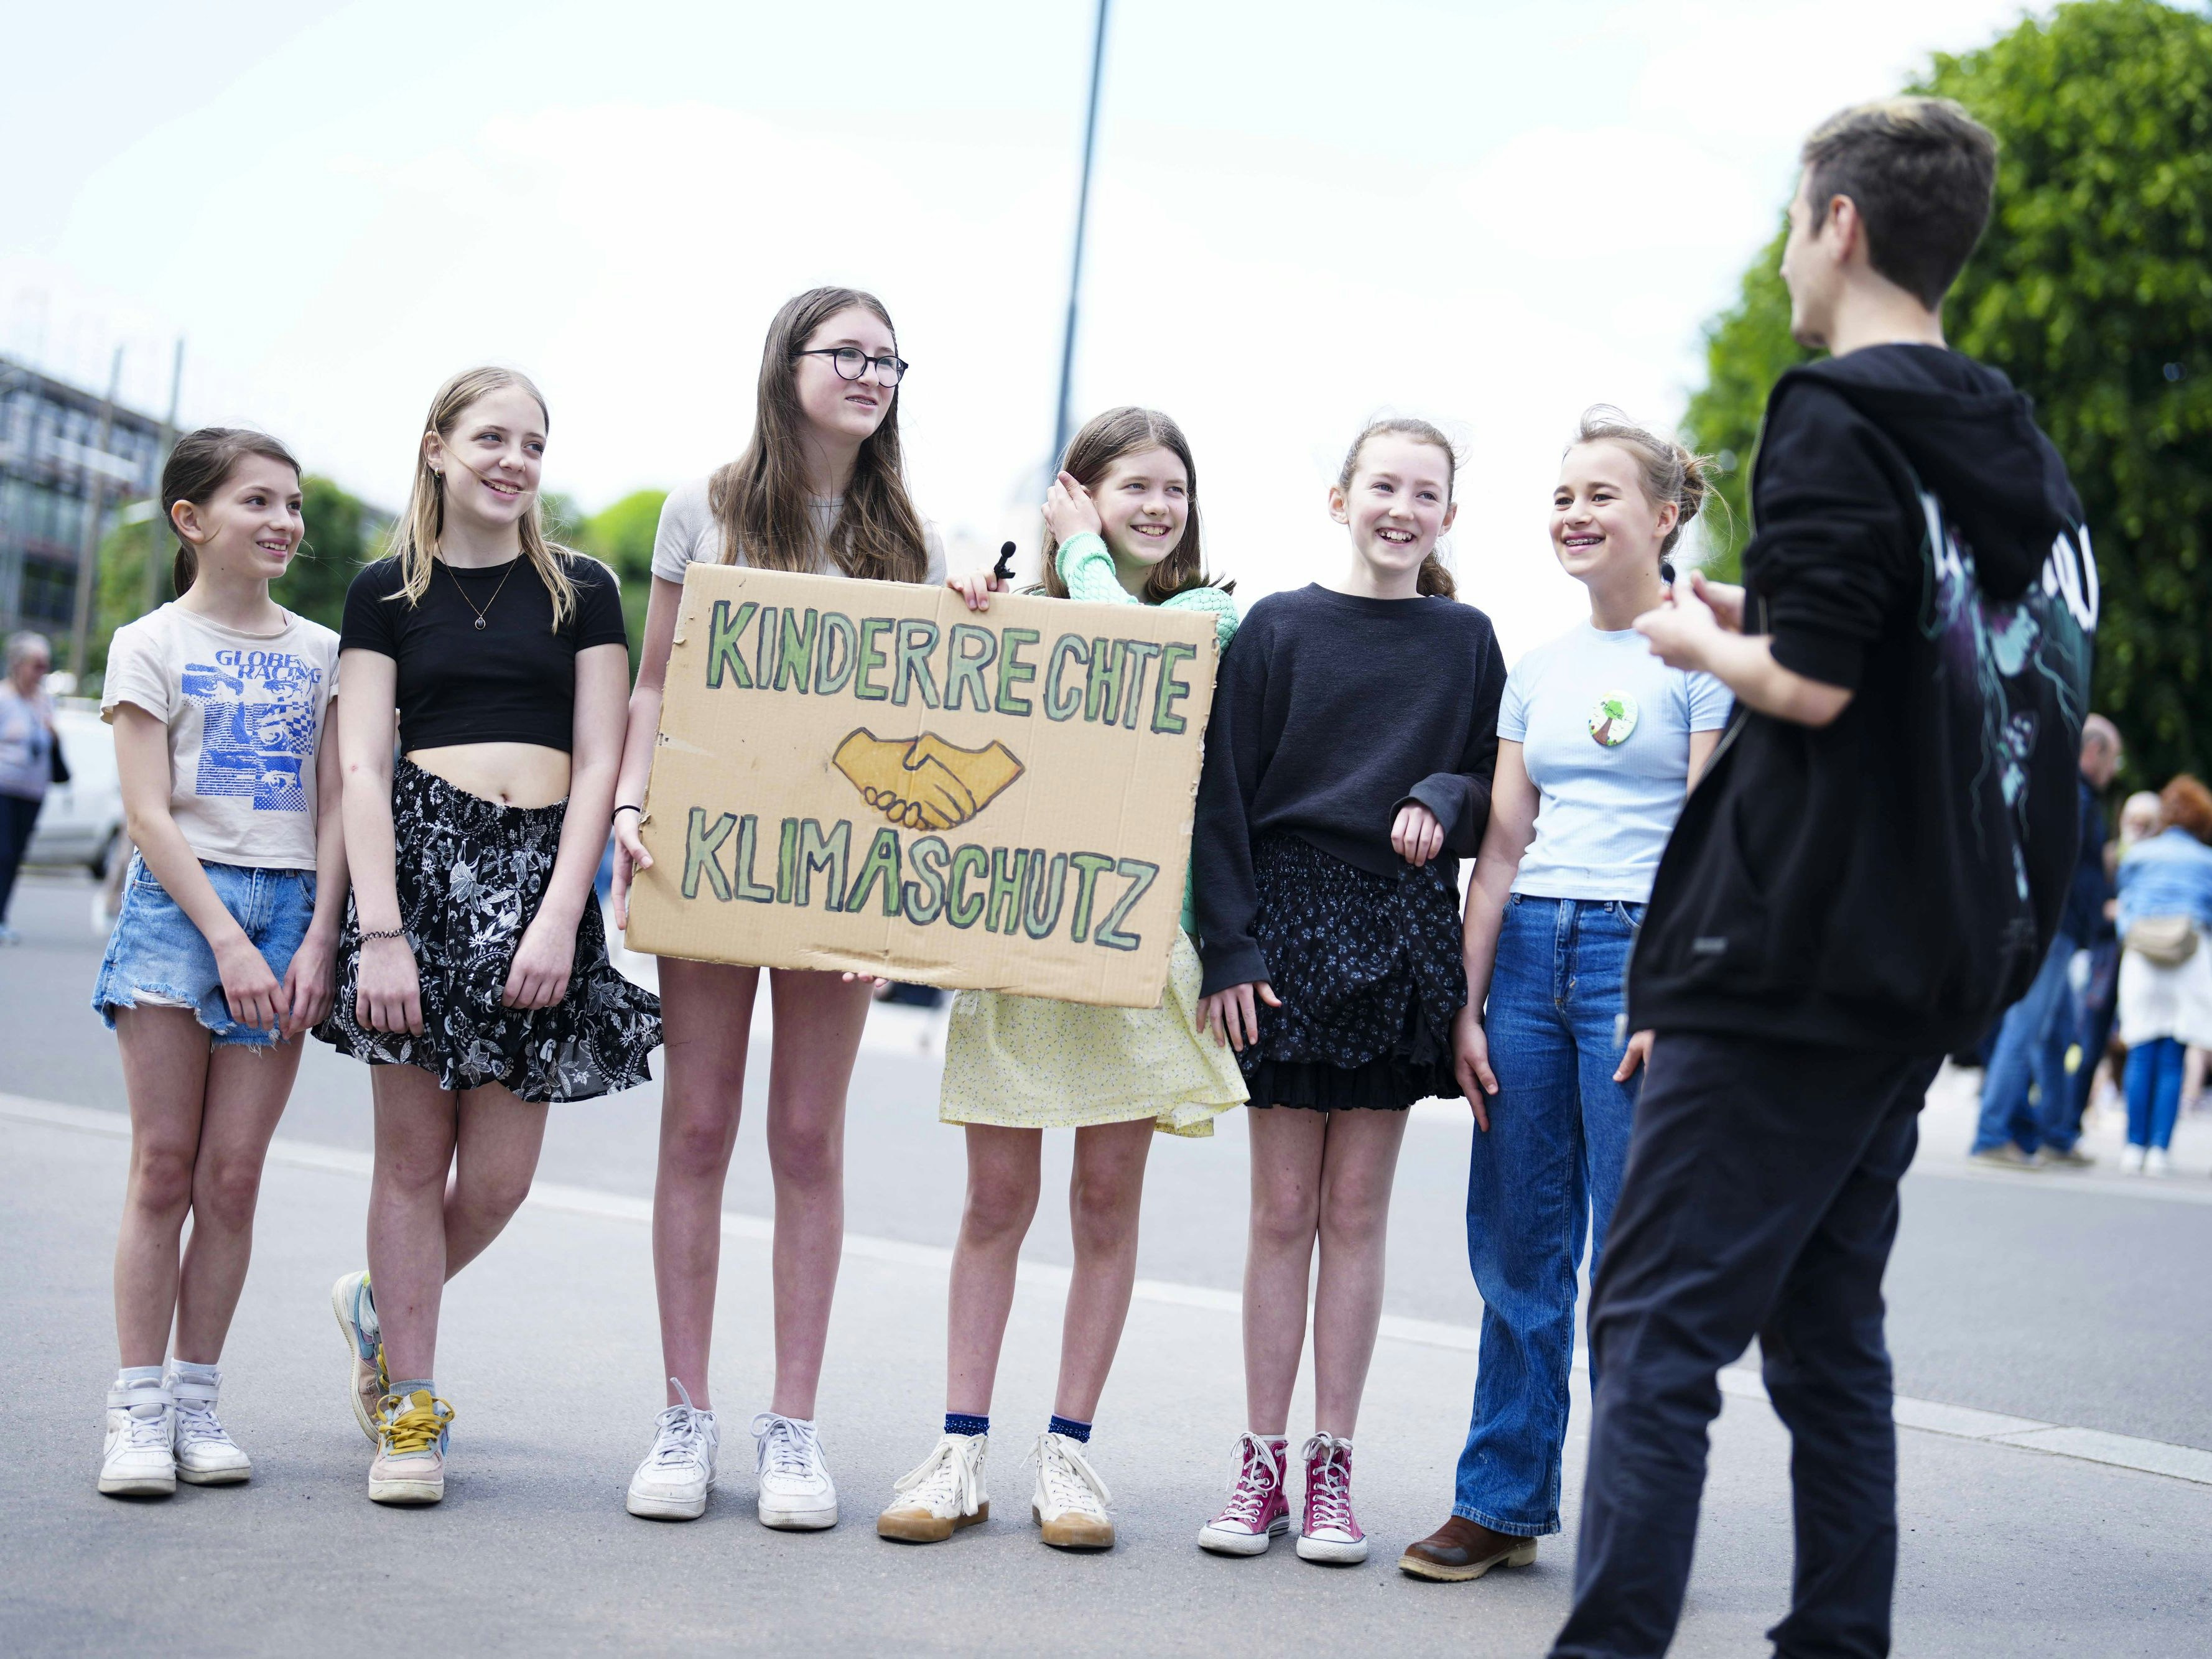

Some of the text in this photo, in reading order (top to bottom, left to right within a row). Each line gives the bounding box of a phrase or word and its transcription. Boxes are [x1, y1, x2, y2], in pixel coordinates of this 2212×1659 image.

[215, 650, 299, 668] GLOBE
[238, 665, 322, 683] RACING
[705, 600, 1197, 735] KINDERRECHTE
[681, 806, 1159, 951] KLIMASCHUTZ
